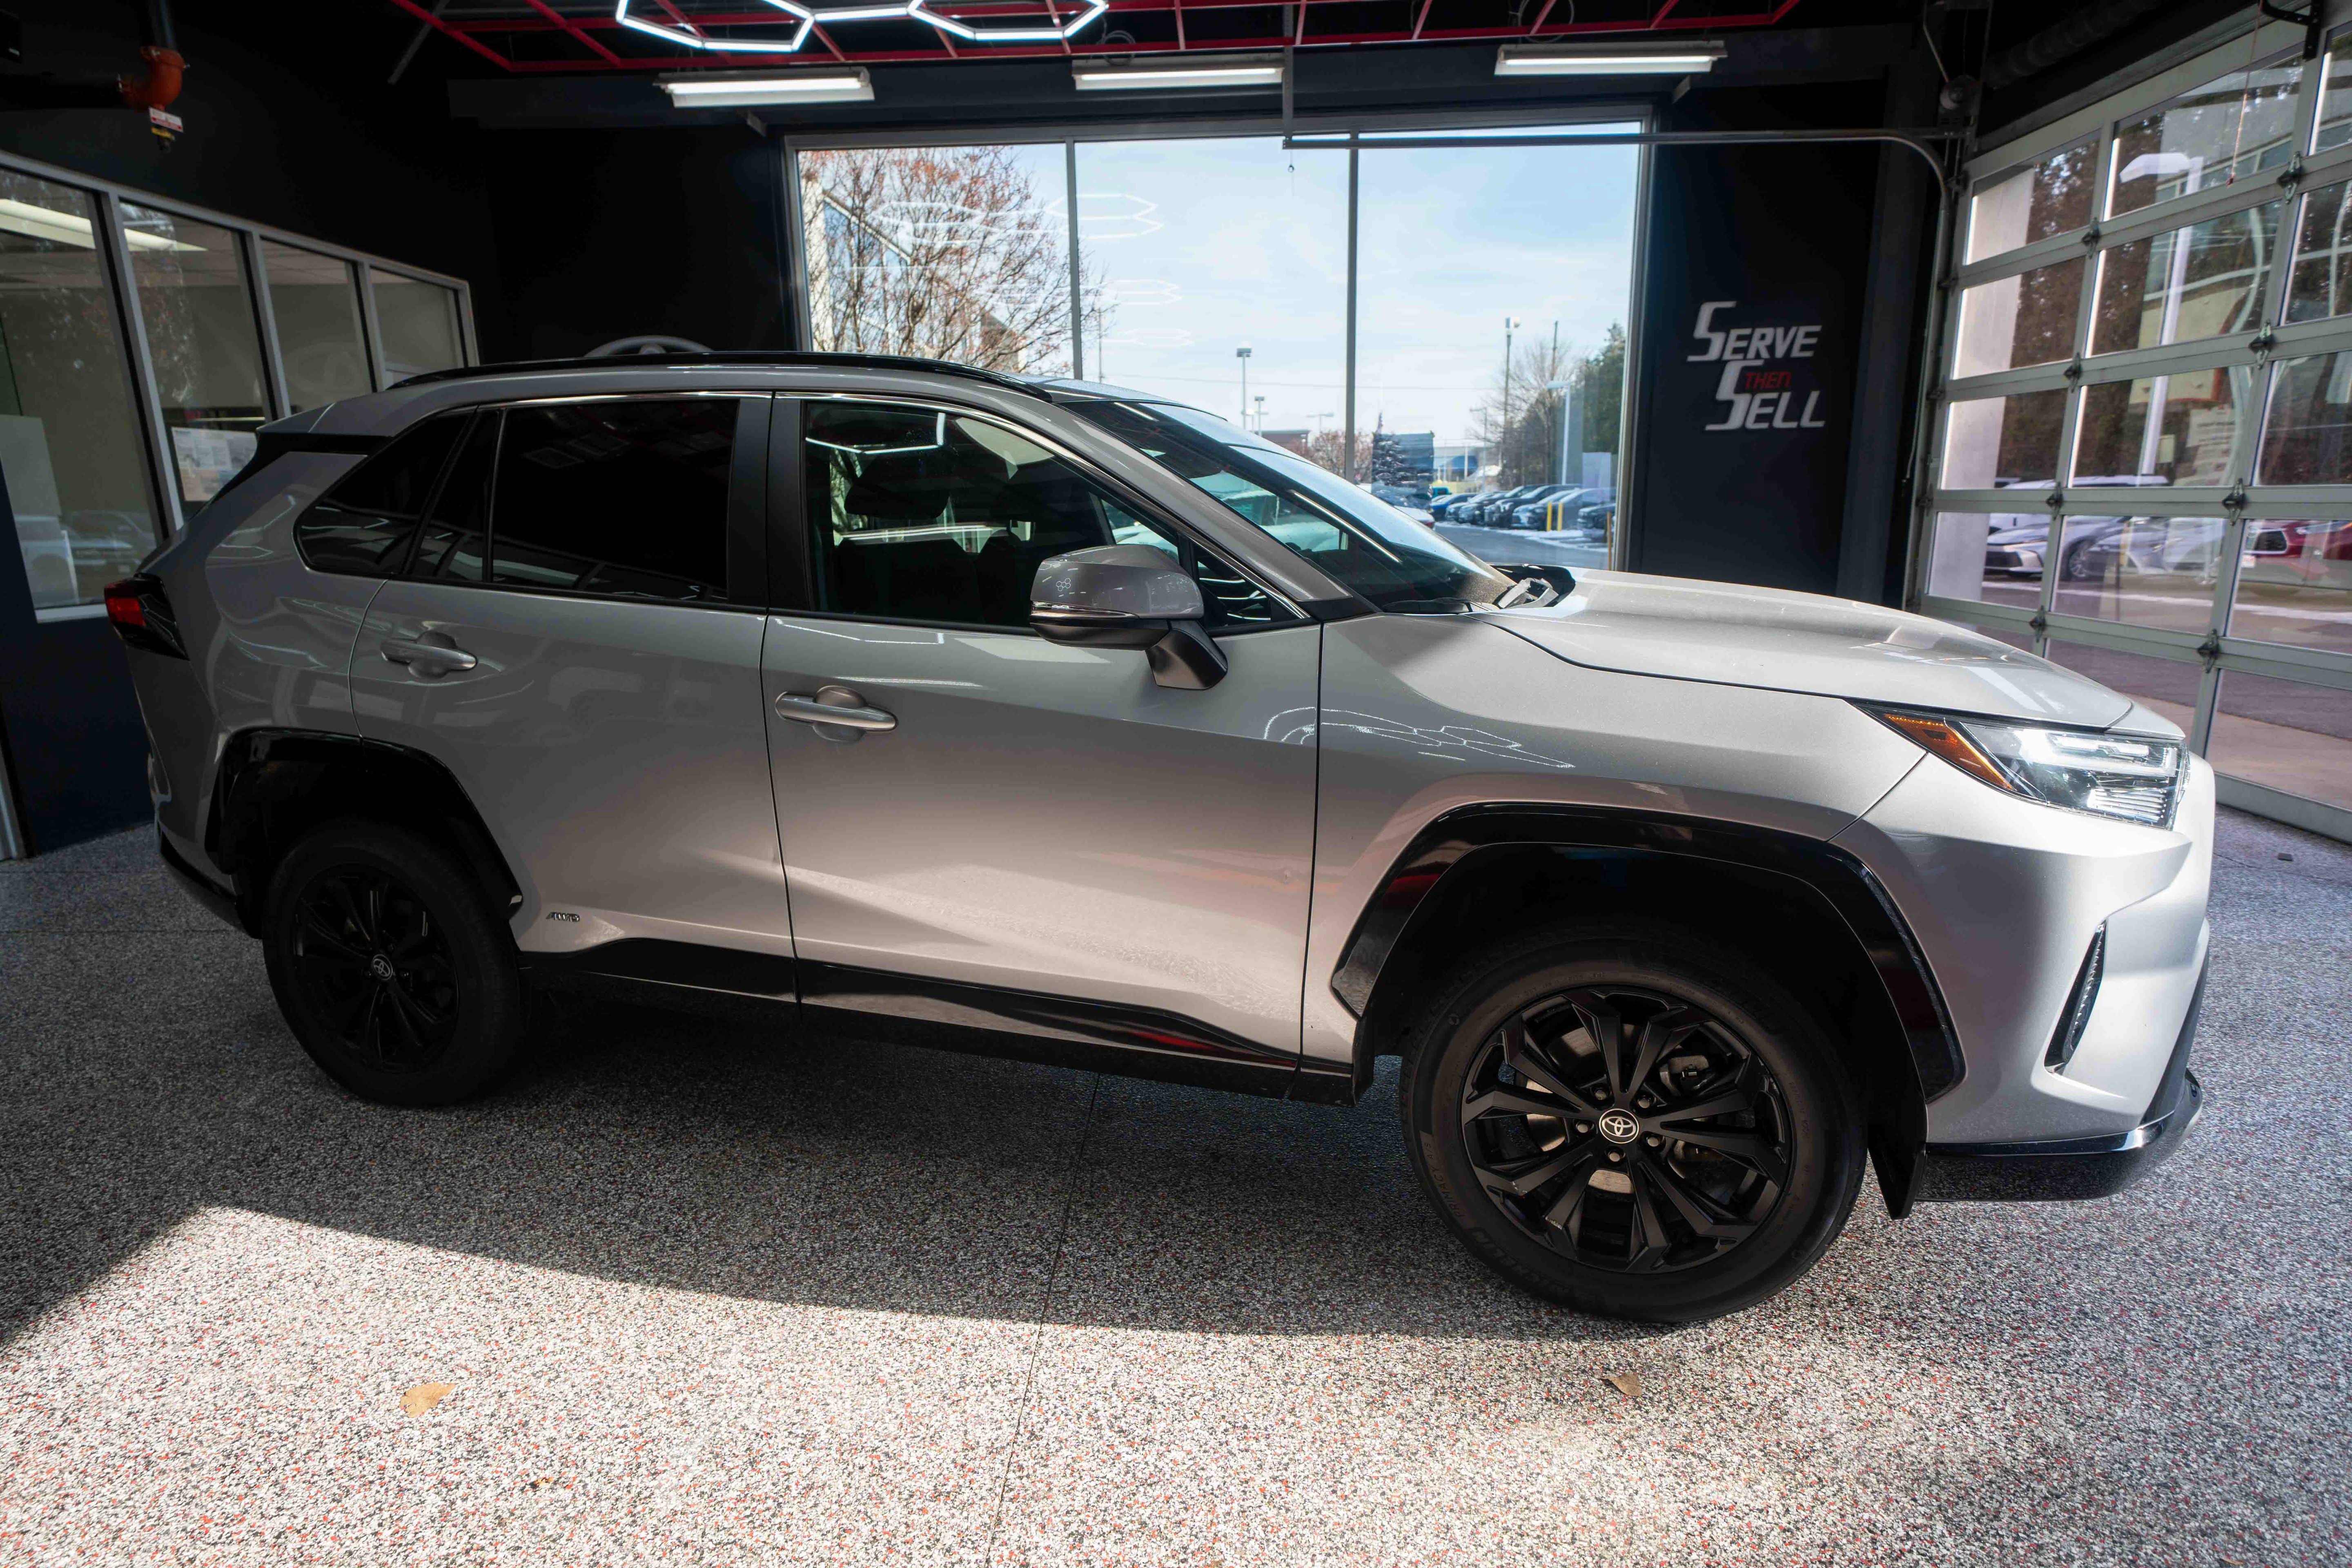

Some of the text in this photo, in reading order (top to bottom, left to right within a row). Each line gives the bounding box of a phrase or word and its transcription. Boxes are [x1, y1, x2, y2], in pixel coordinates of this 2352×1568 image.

[1686, 301, 1822, 362] SERVE
[1705, 360, 1826, 431] SELL
[1744, 371, 1791, 390] THEN
